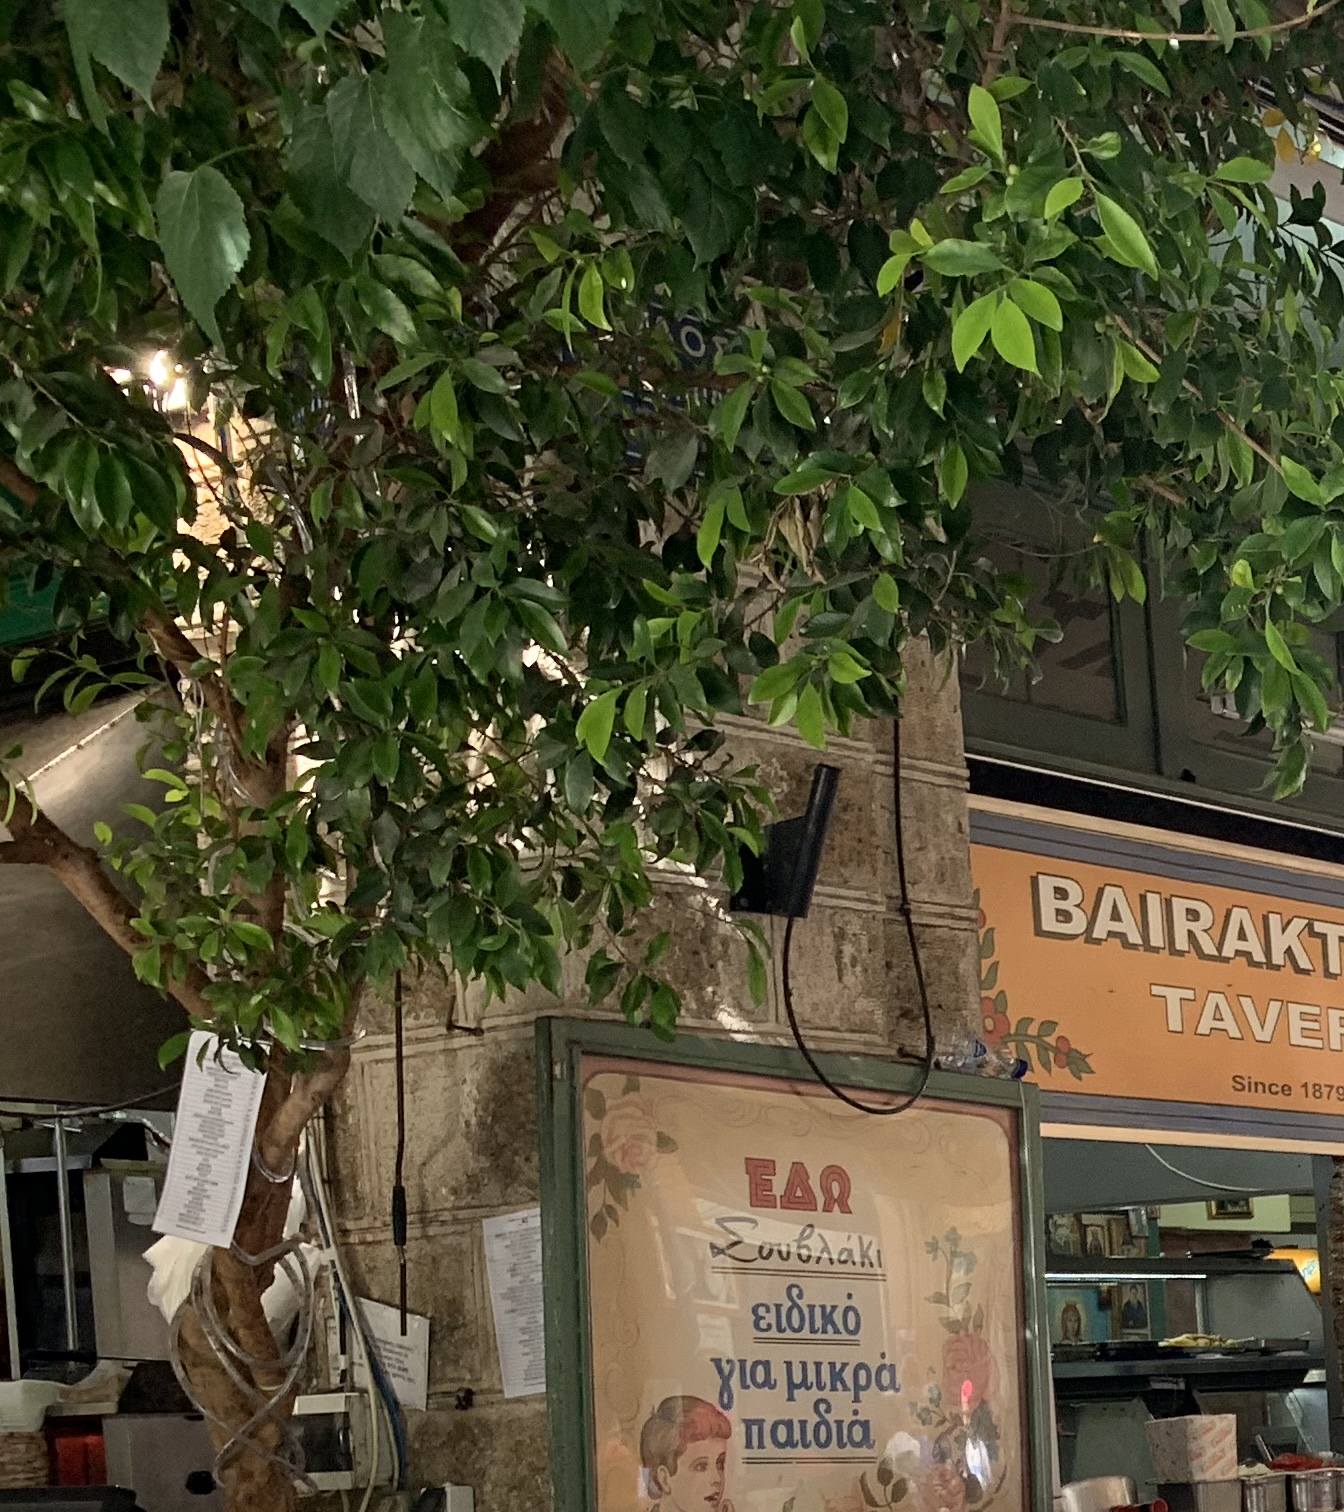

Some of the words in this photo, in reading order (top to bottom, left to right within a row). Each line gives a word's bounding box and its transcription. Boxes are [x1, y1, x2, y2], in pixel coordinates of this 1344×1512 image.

[1231, 1073, 1292, 1099] Since
[744, 1156, 852, 1215] ΕΔΩ
[709, 1215, 883, 1269] Σουβλάκι
[751, 1283, 862, 1336] ειδικό
[709, 1357, 777, 1411] για
[783, 1351, 901, 1404] μικρά
[741, 1397, 876, 1450] παιδιά
